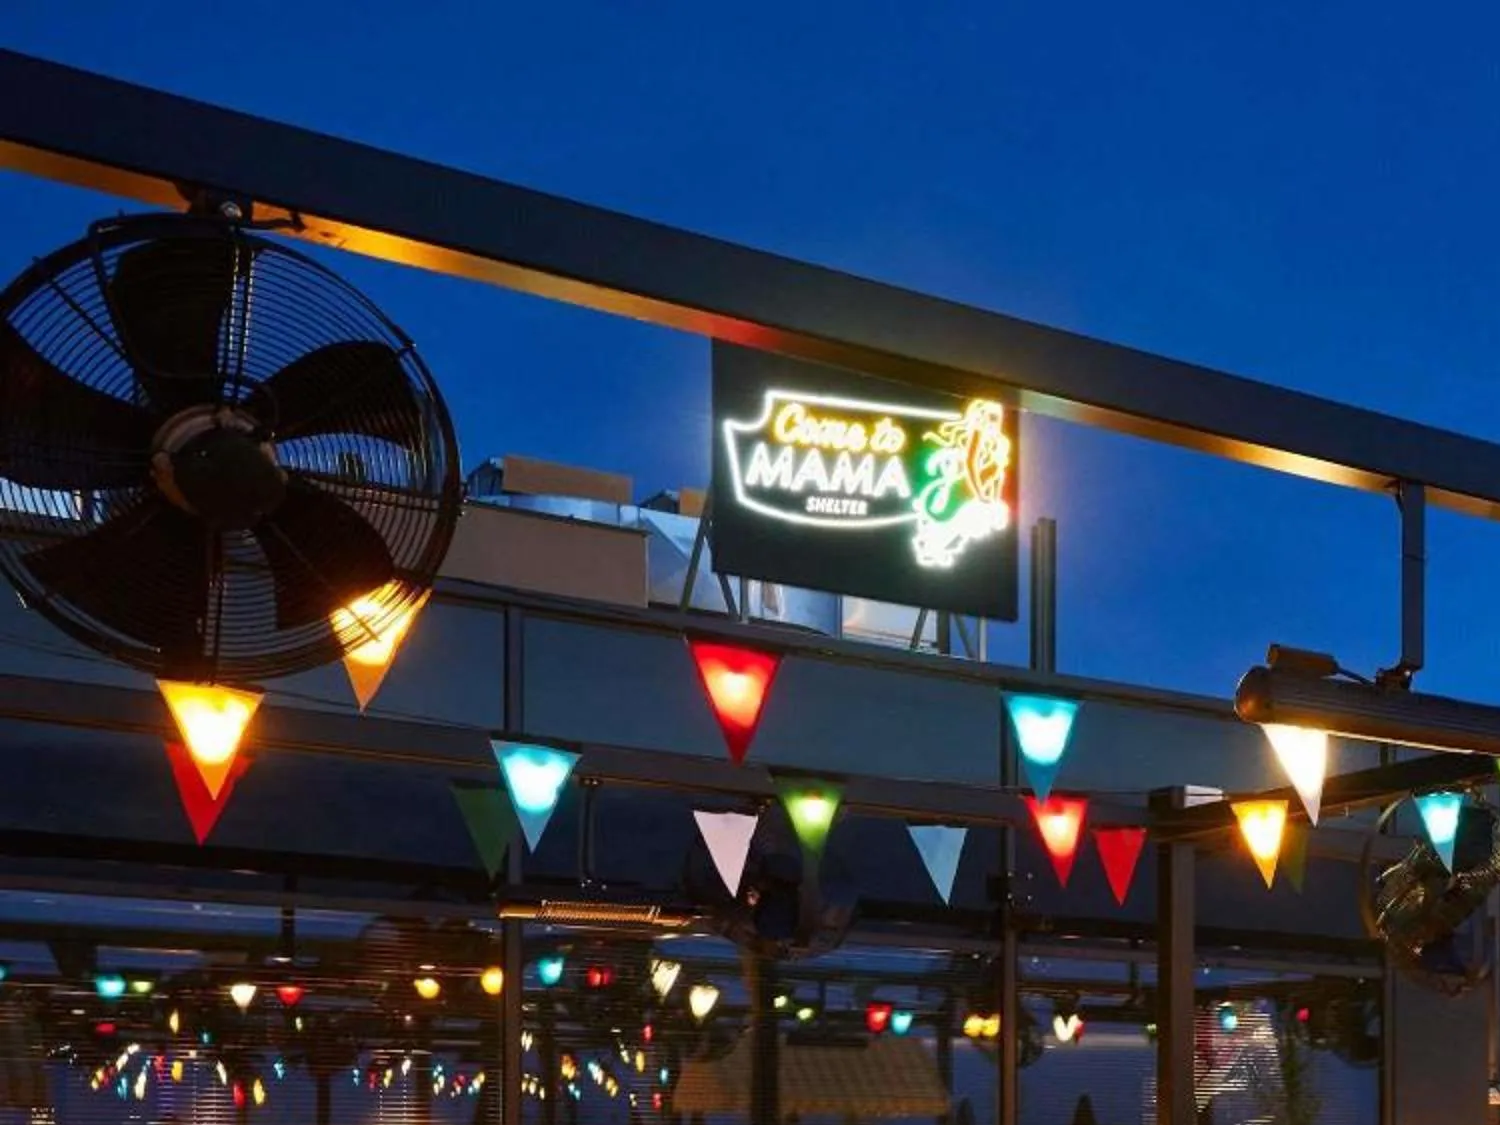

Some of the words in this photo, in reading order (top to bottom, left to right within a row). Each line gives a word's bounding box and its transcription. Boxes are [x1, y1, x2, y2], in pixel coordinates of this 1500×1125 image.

[774, 402, 867, 452] Come
[870, 416, 907, 453] to
[745, 443, 911, 498] MAMA
[805, 496, 868, 516] SHELTER
